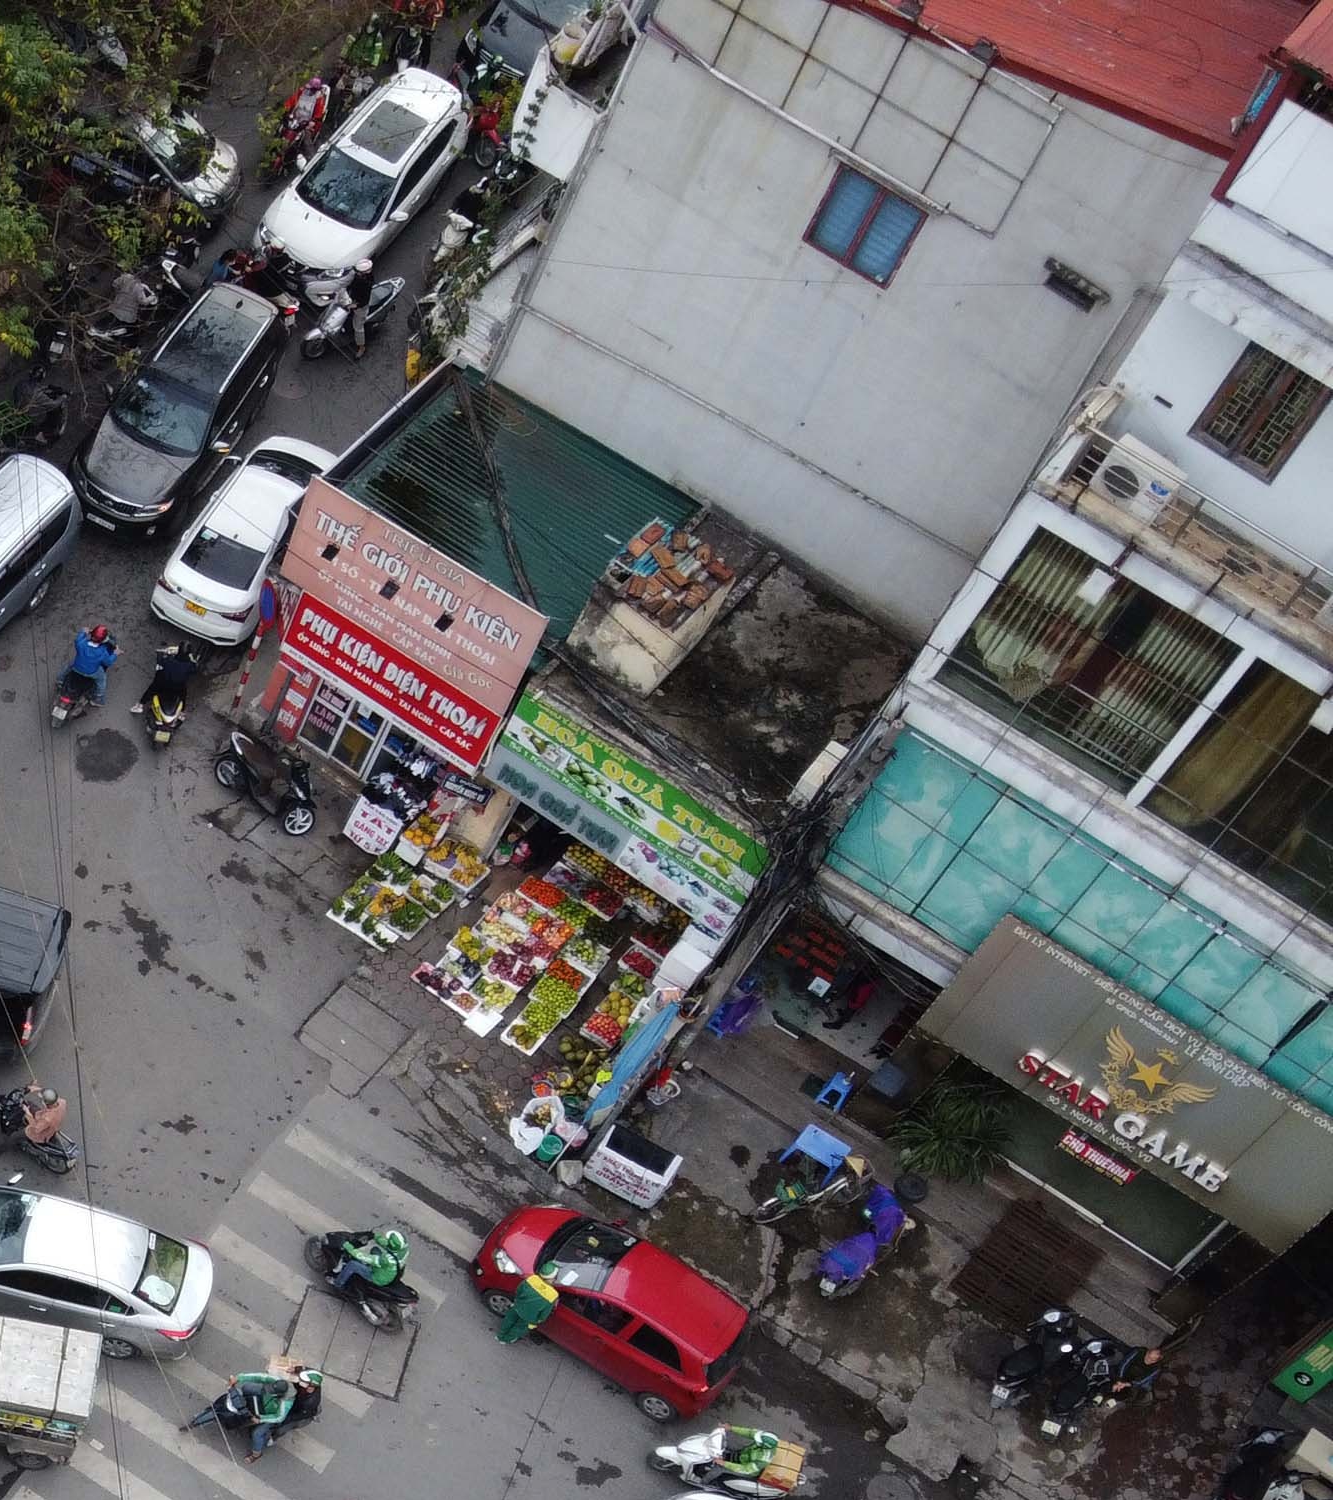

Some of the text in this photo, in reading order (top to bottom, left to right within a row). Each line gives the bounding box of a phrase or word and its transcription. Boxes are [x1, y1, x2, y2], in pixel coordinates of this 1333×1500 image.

[316, 508, 364, 551] THẾ
[361, 540, 411, 583] GIỚI
[464, 603, 522, 651] KIỆN
[435, 560, 466, 588] GIA
[299, 607, 340, 646] PHỤ
[338, 632, 385, 674] KIỆN
[534, 711, 746, 862] HOA QUẢ TƯƠI
[1045, 945, 1092, 977] INTERNET
[1197, 1055, 1224, 1075] MINH
[1017, 1047, 1110, 1120] STAR
[1113, 1111, 1230, 1193] GAME
[1062, 1132, 1084, 1155] CHO
